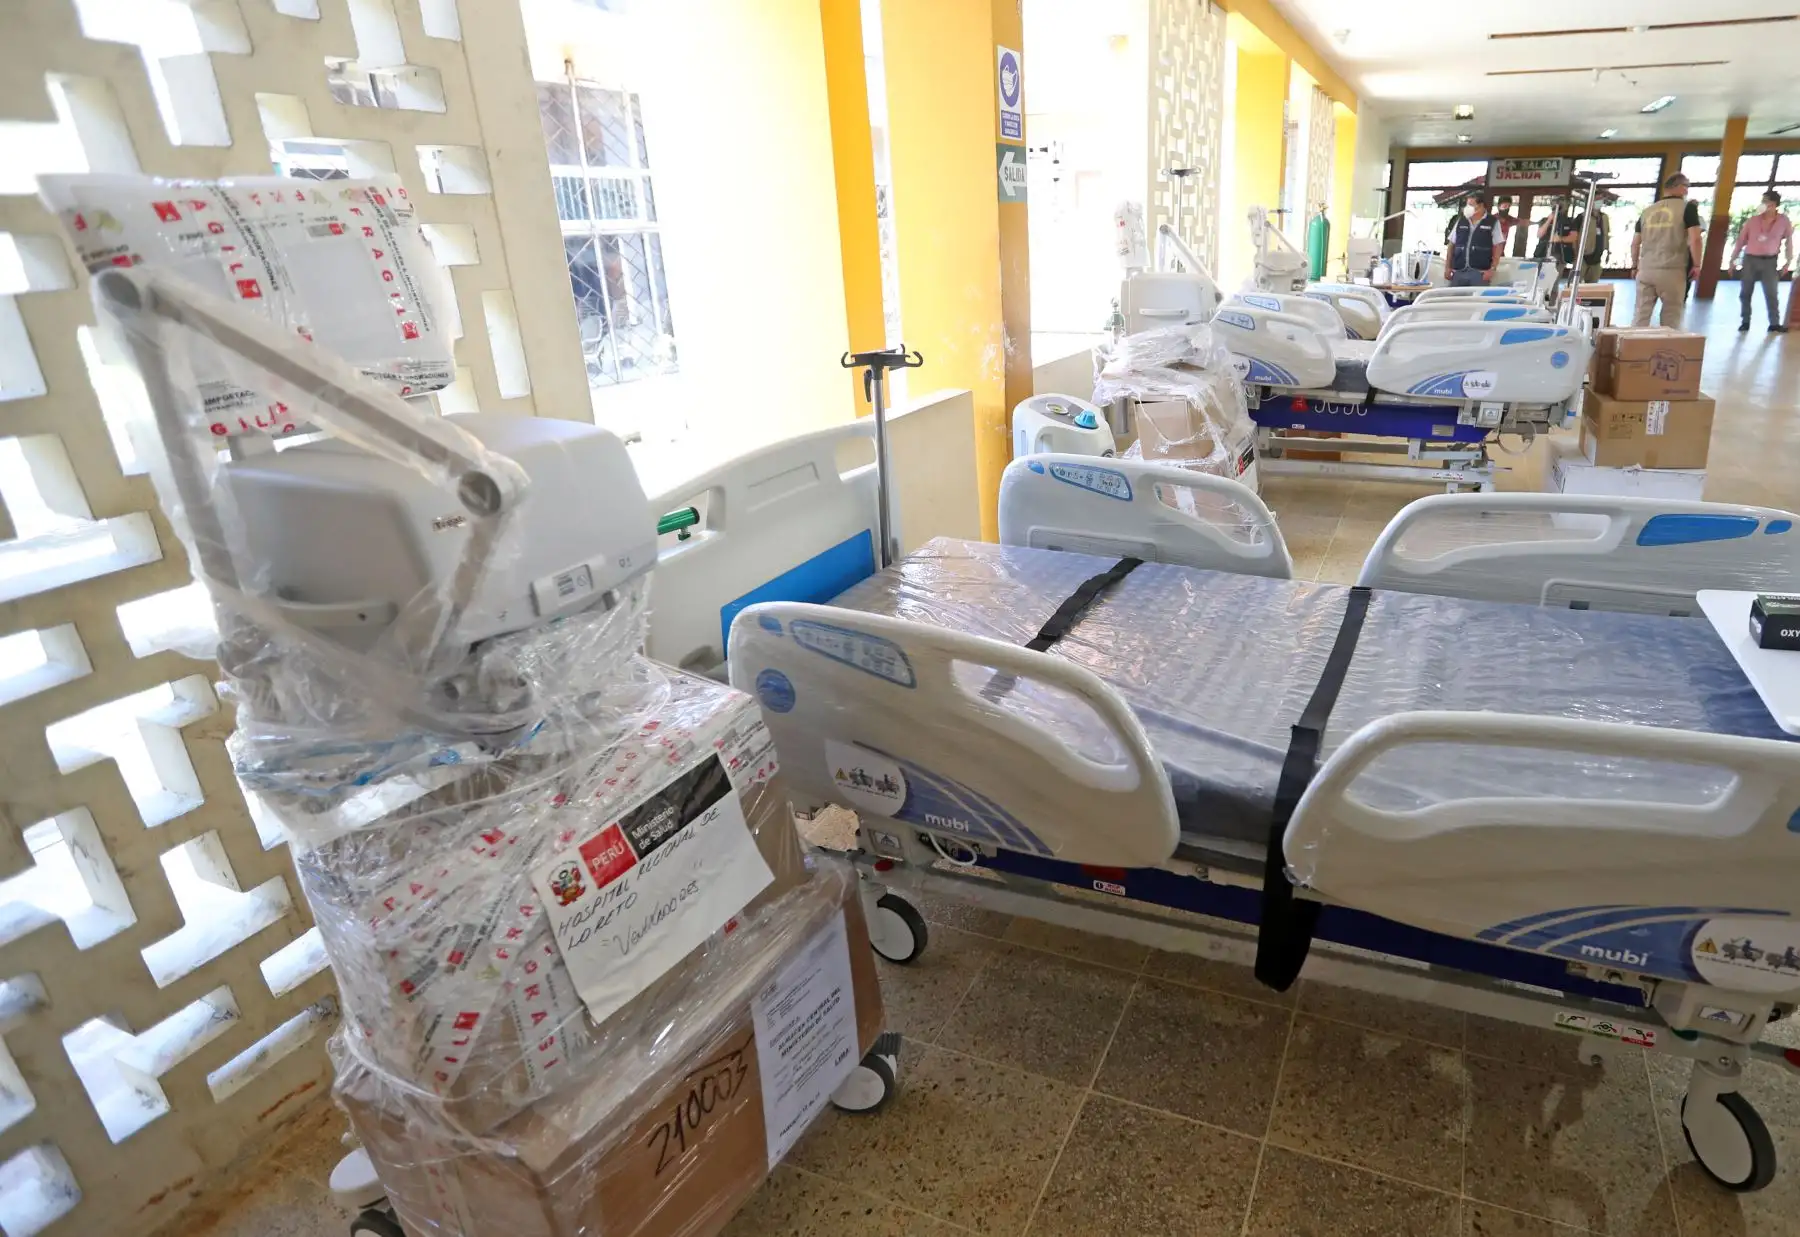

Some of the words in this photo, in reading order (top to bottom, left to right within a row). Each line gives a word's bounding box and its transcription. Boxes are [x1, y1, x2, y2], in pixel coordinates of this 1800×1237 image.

[1004, 165, 1025, 183] SALIDA
[1521, 160, 1558, 169] SALIDA
[631, 806, 675, 840] Ministerio
[638, 837, 652, 850] de
[650, 821, 675, 842] Salud
[925, 813, 969, 832] mubi
[591, 840, 626, 873] PERÚ
[558, 878, 631, 937] HOSPITAL
[700, 807, 720, 827] DE
[567, 891, 638, 951] LORETO
[1581, 944, 1649, 967] mubi
